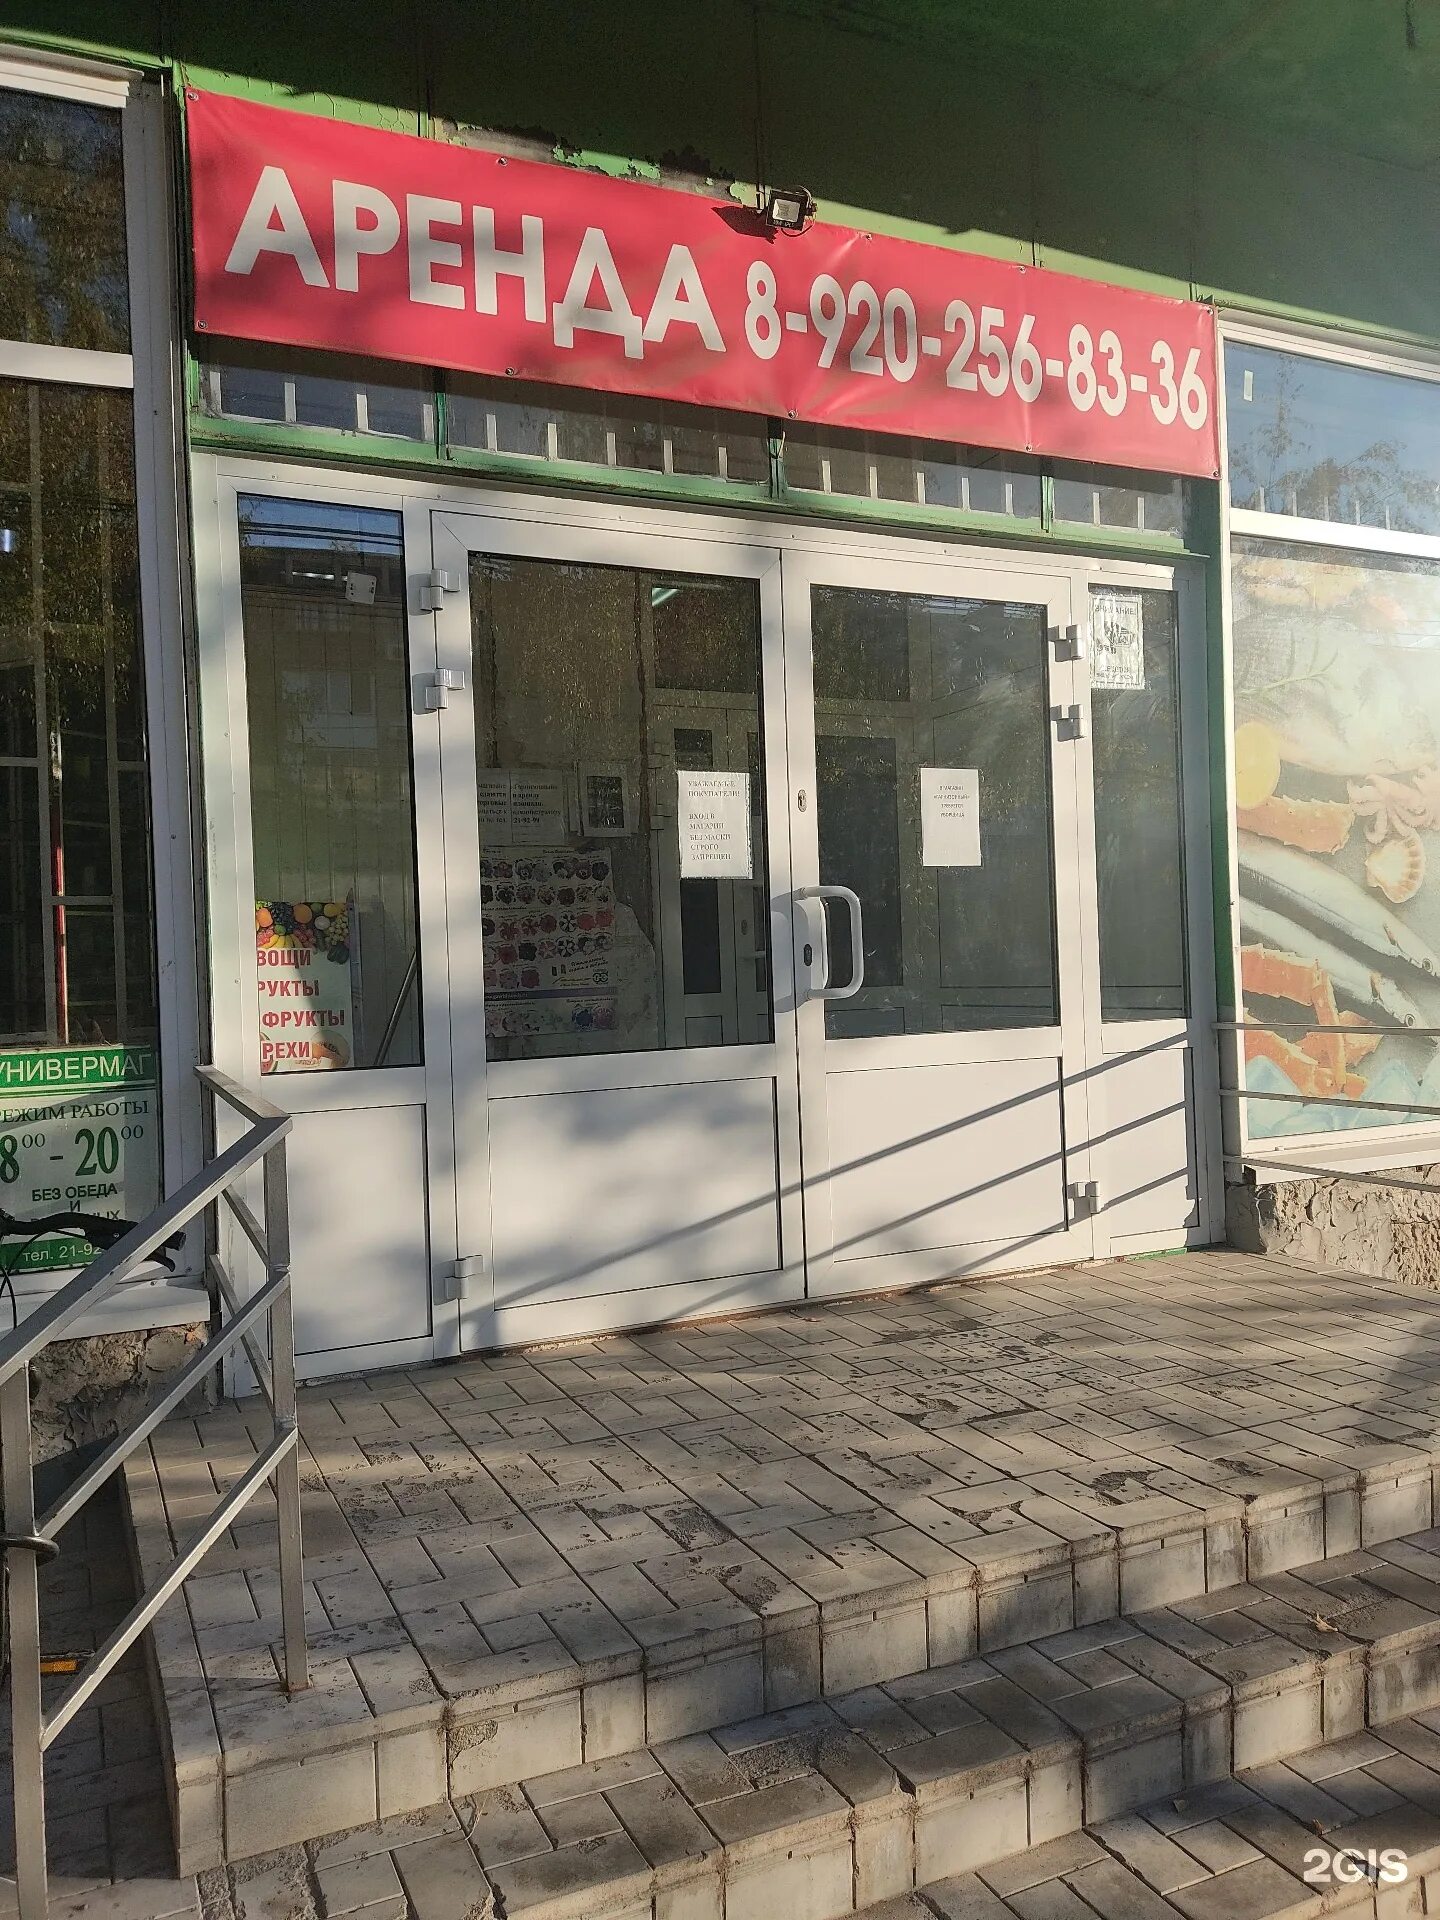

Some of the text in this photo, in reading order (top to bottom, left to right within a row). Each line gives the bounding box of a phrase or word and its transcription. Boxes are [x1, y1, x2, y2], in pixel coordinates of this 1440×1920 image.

[224, 165, 1208, 431] АРЕНДА 8-920-256-83-36
[262, 1010, 345, 1028] ФРУКТЫ
[262, 1041, 310, 1060] РЕХИ
[0, 1100, 149, 1123] ЕЖИМ РАБОТЫ
[32, 1182, 118, 1202] БЕЗ ОБЕДА
[69, 1200, 81, 1212] И
[23, 1249, 54, 1262] тел.
